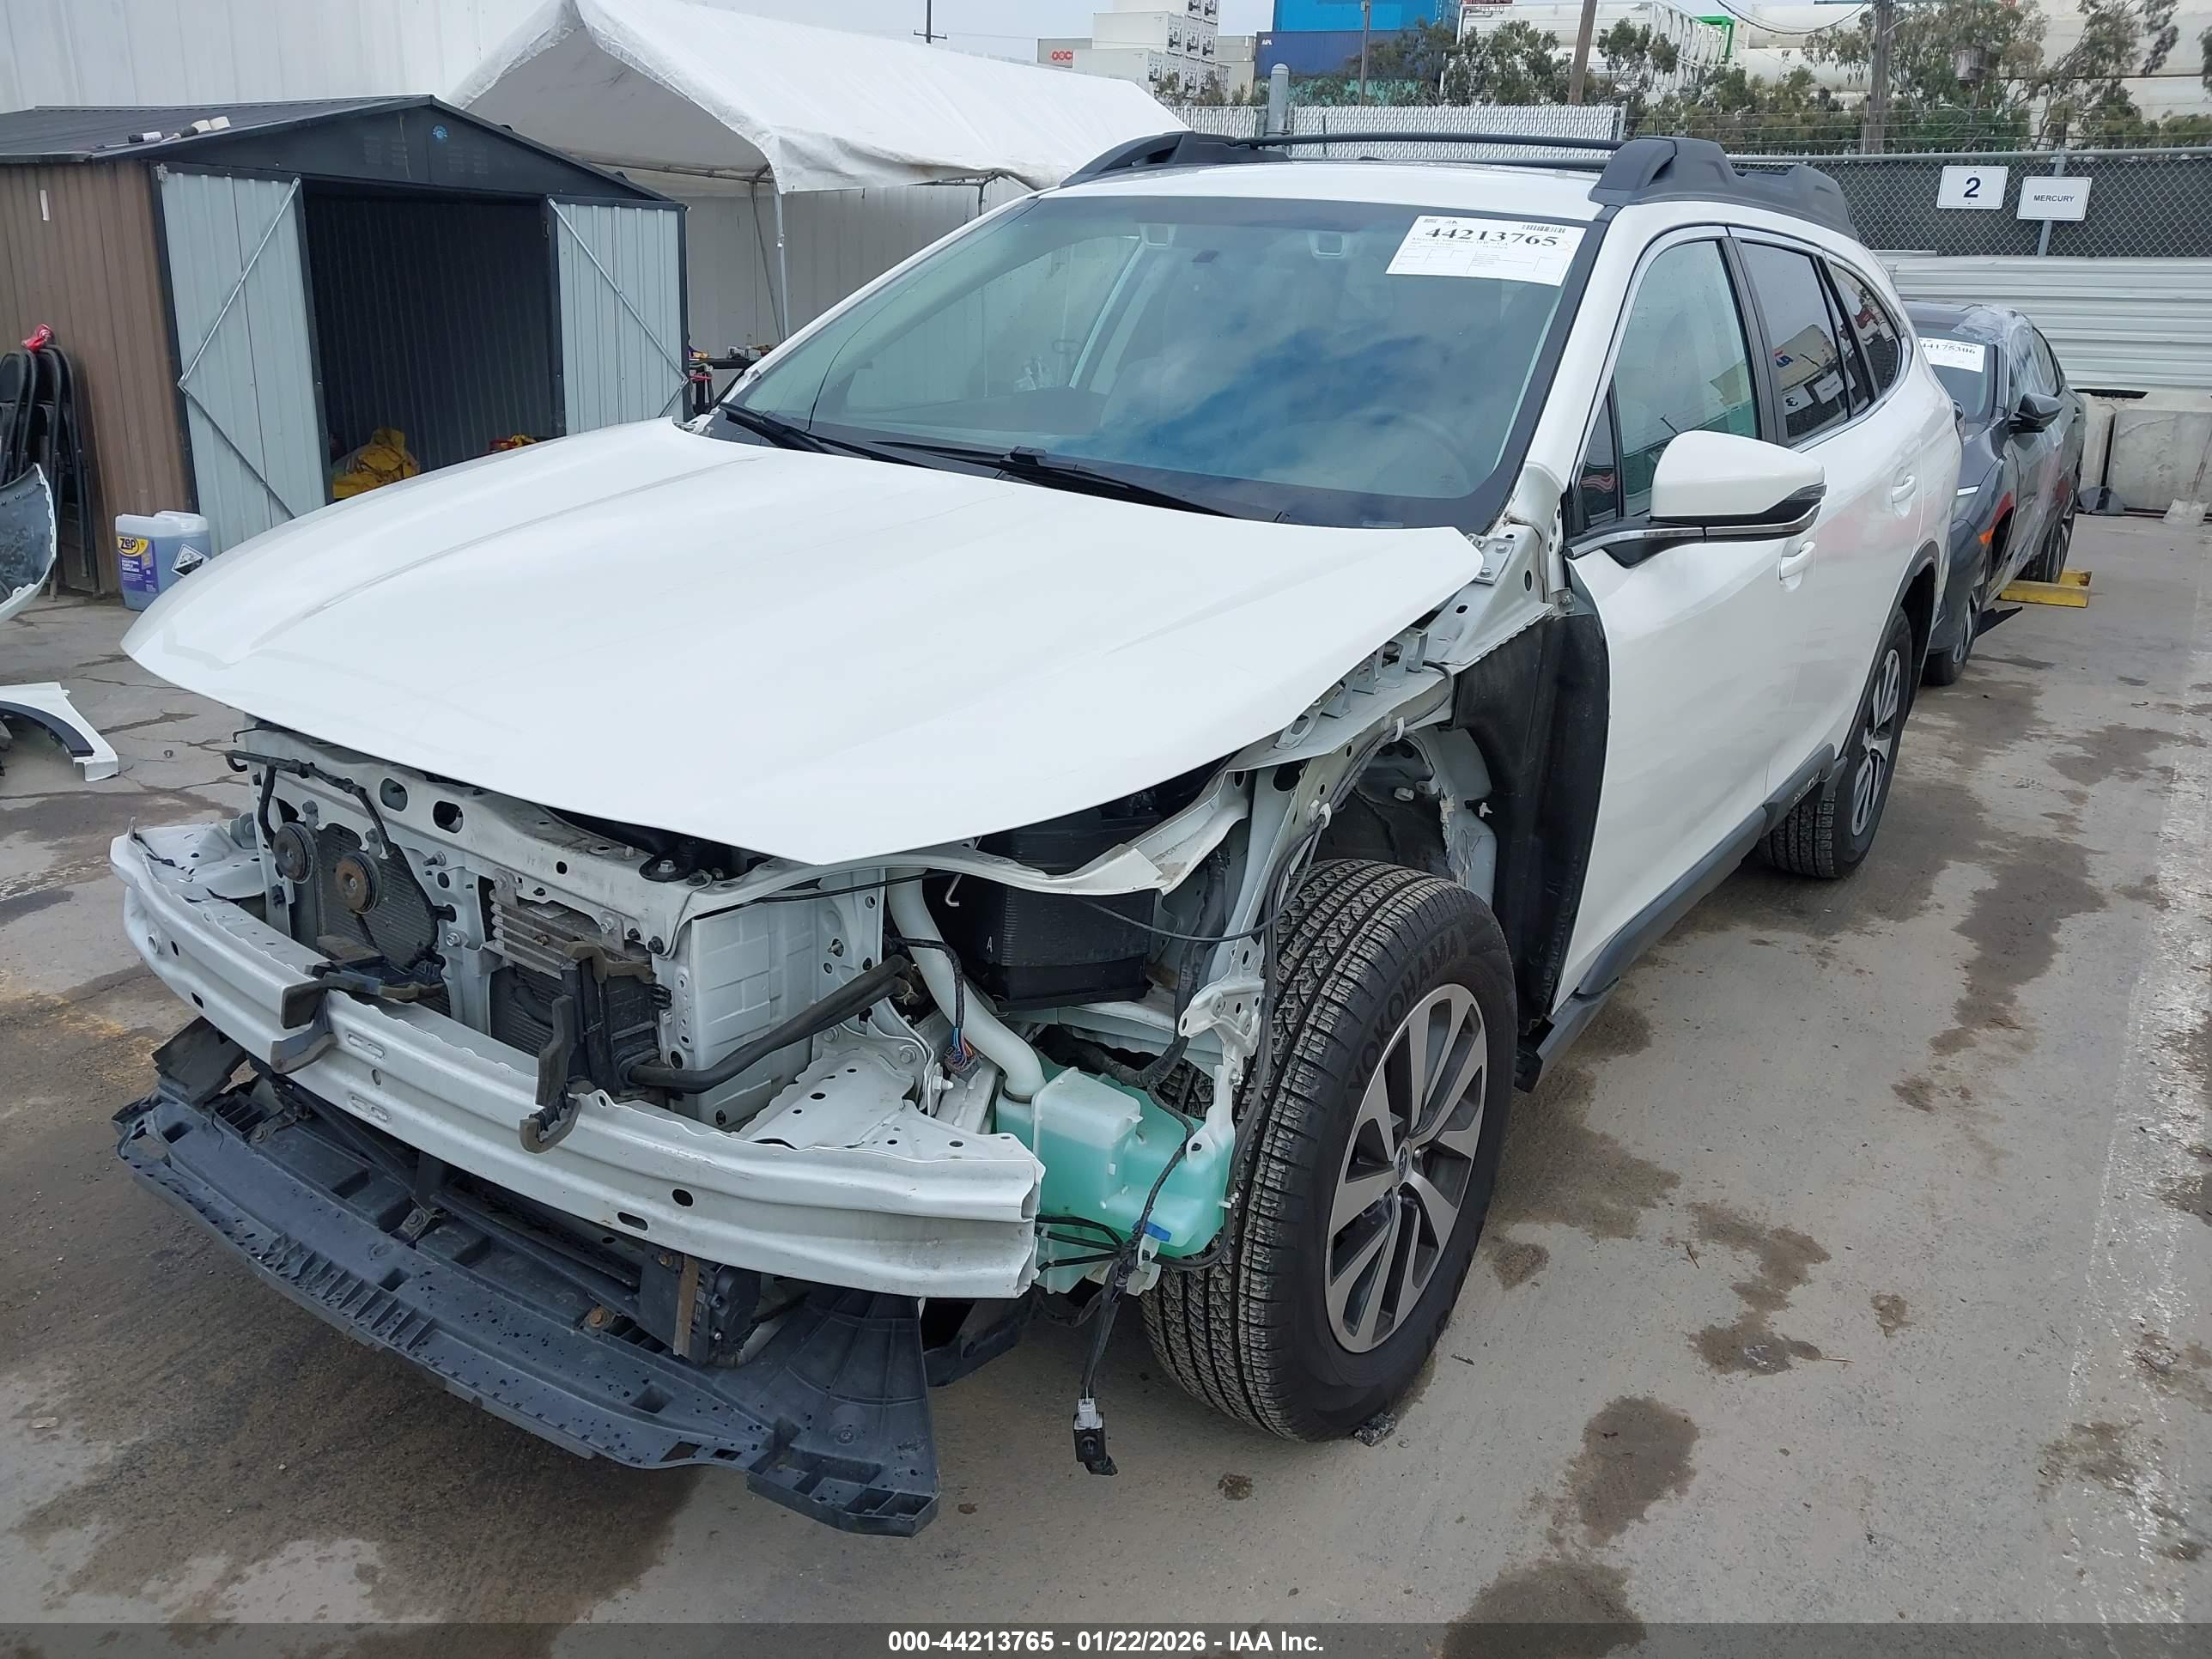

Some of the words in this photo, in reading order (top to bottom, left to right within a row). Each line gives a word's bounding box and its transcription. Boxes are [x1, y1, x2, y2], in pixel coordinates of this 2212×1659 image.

[1963, 177, 1981, 198] 2
[2033, 194, 2075, 203] MERCURY
[1425, 228, 1559, 246] 44213765
[986, 935, 993, 954] A
[1348, 929, 1462, 1089] YOKOHAMA
